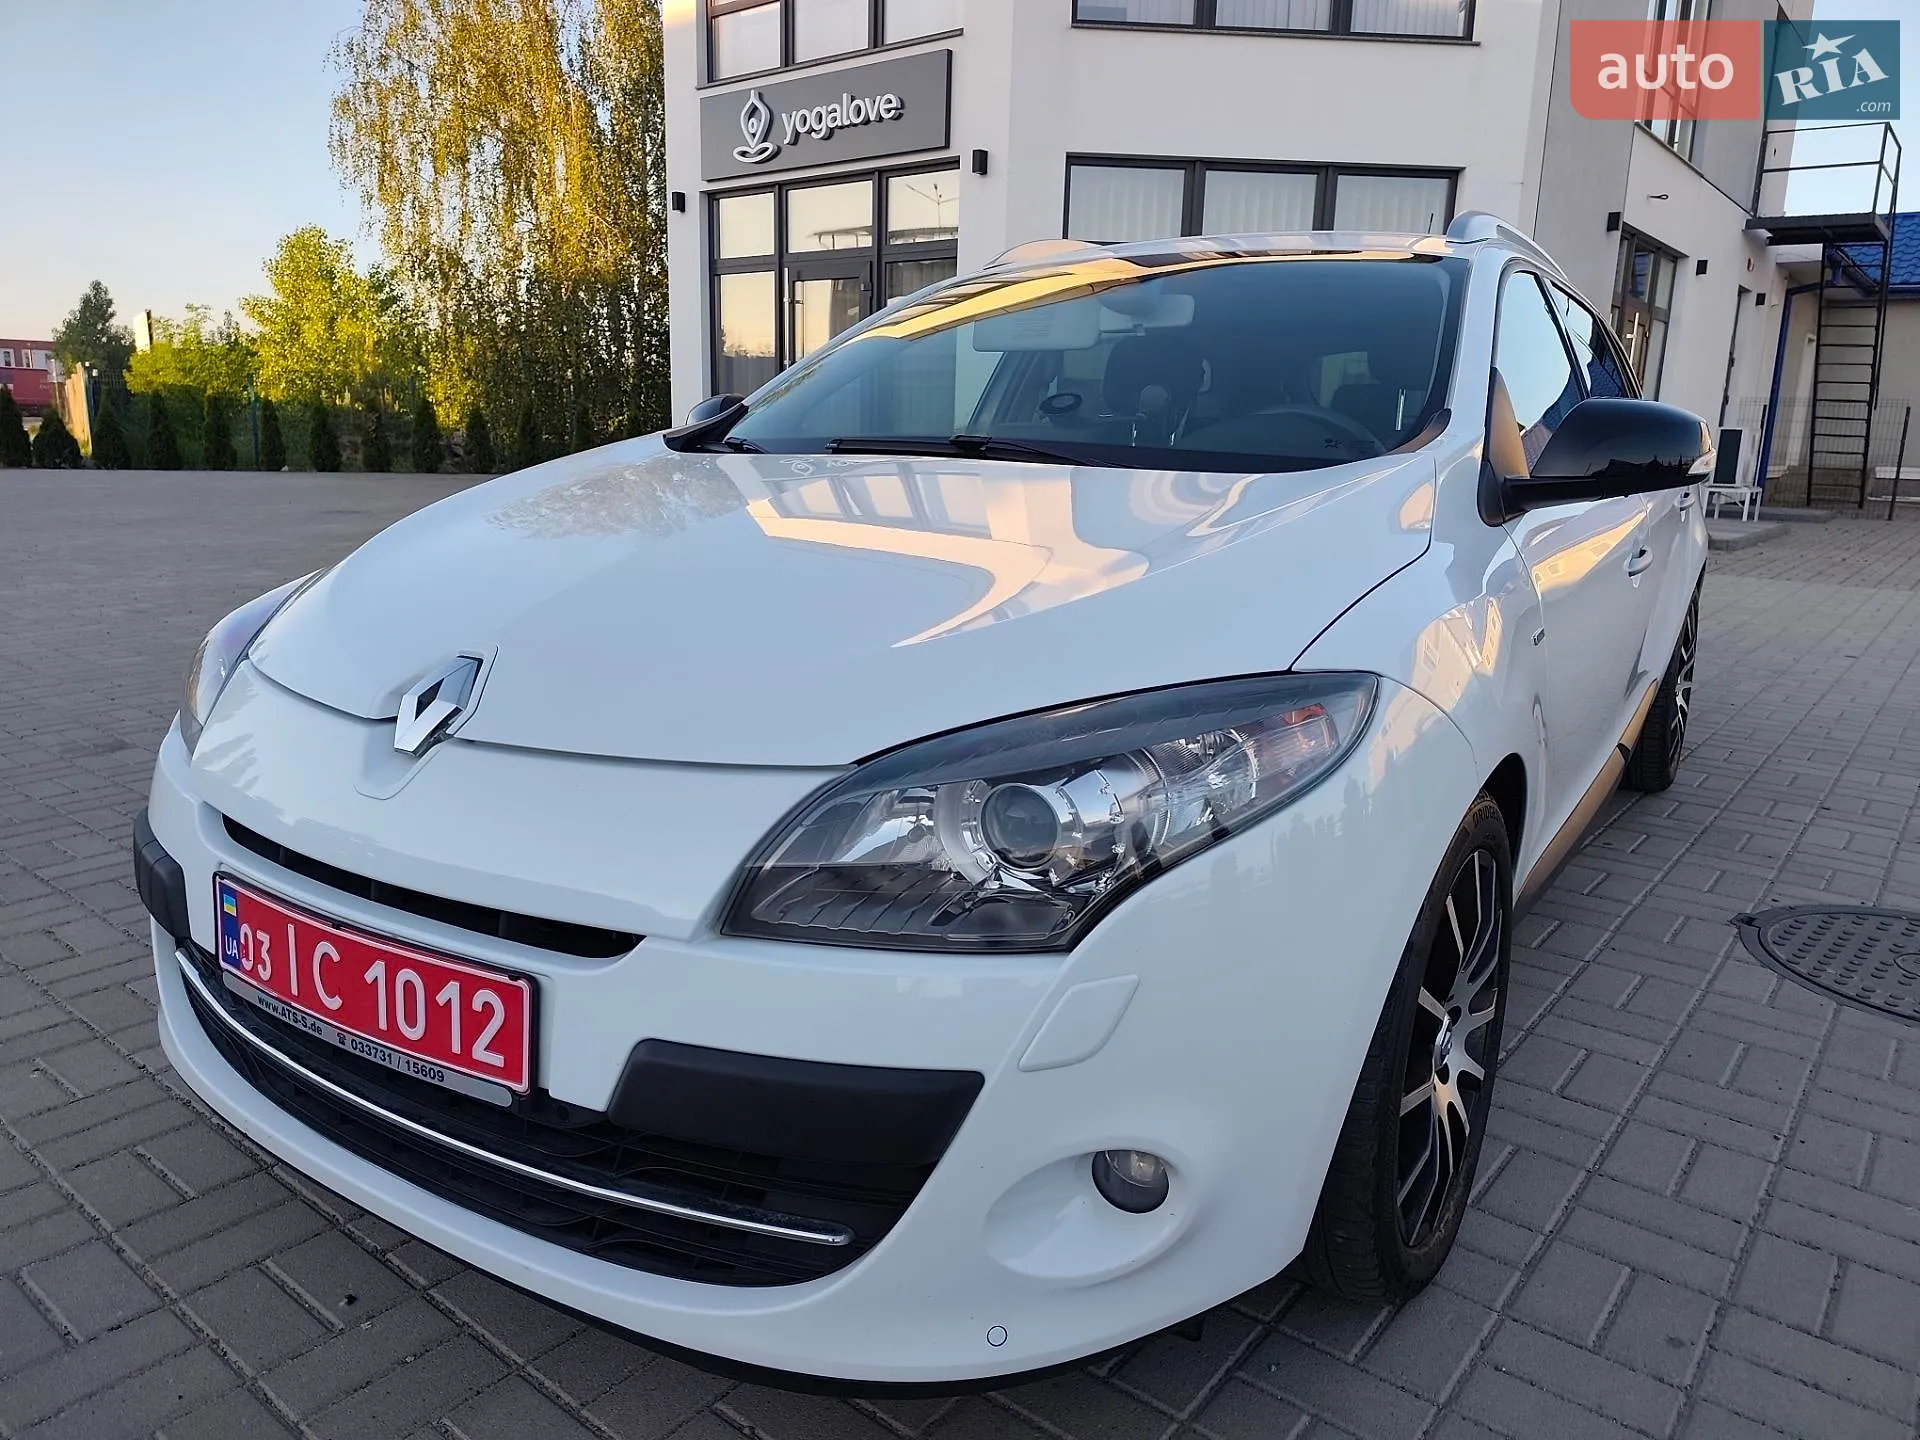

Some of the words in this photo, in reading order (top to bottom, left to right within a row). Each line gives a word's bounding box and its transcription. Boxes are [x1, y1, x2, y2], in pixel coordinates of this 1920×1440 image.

[782, 92, 902, 145] yogalove
[225, 934, 239, 961] UA
[239, 923, 272, 982] 03
[363, 960, 505, 1068] 1012
[257, 995, 323, 1037] www.ATS-S.de
[350, 1038, 393, 1066] 033731
[405, 1059, 446, 1083] 15609
